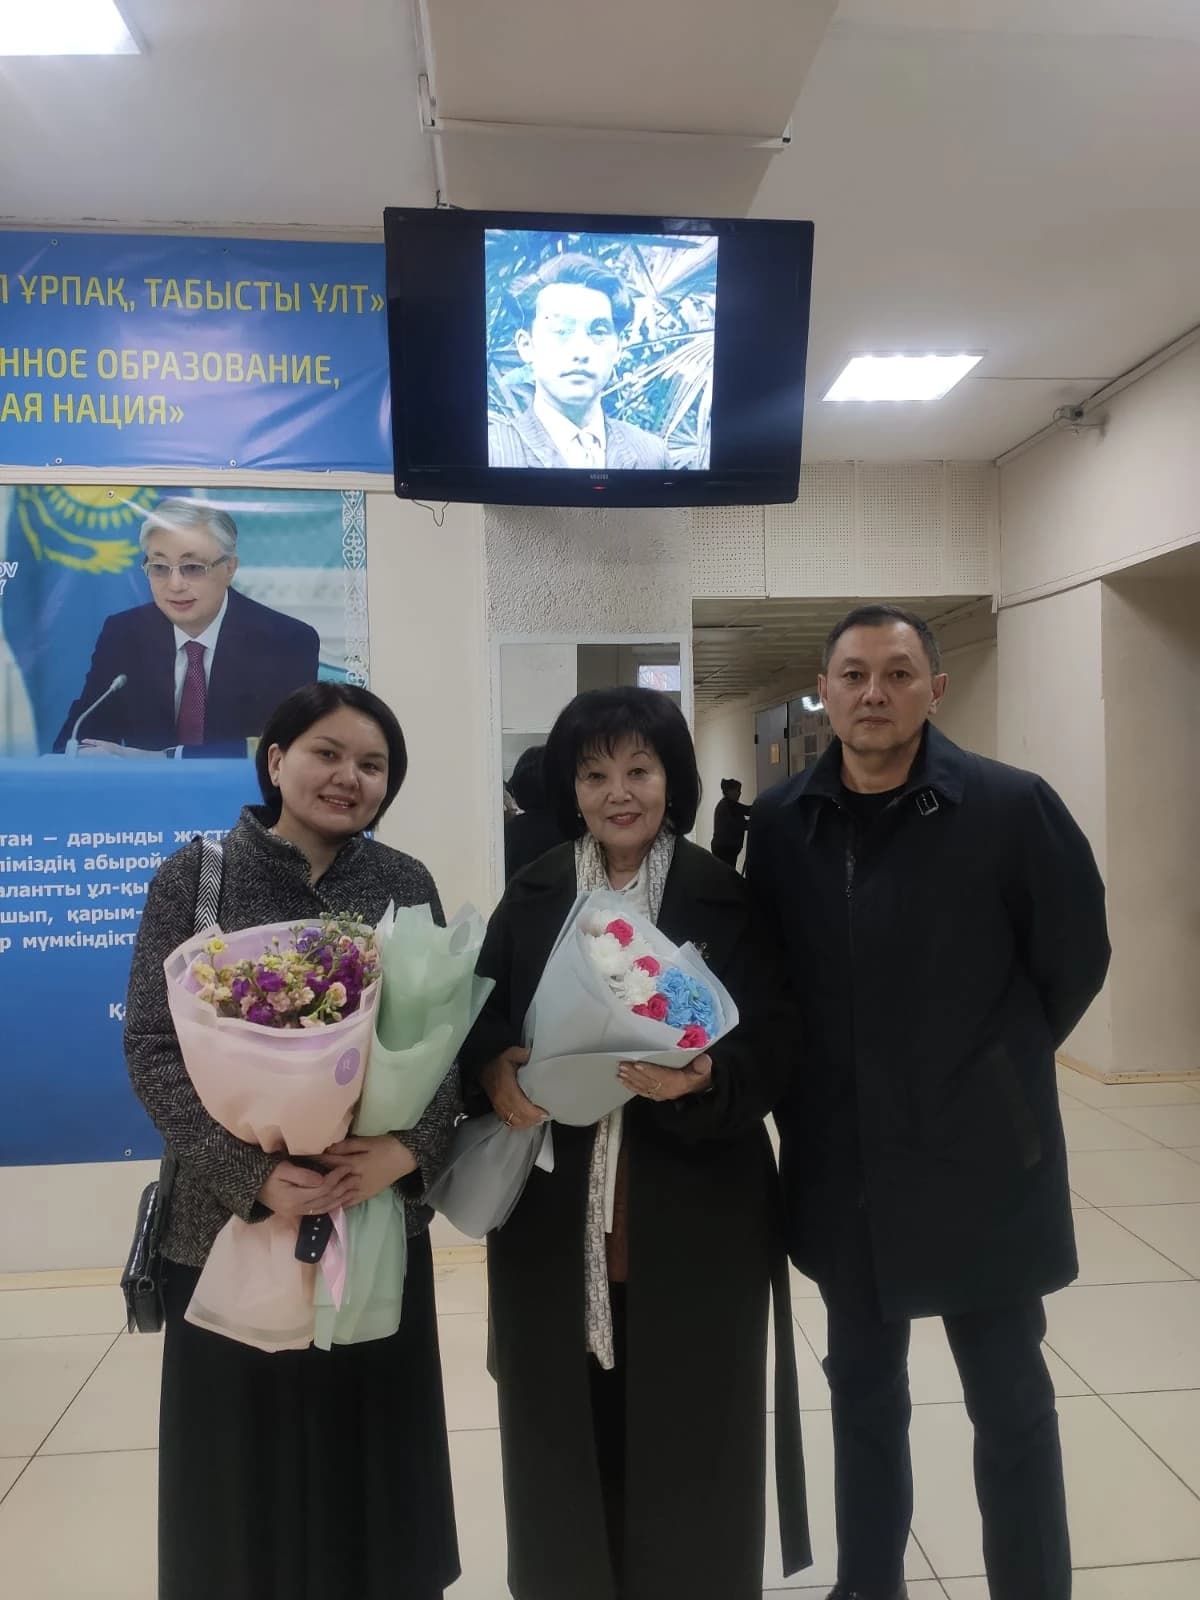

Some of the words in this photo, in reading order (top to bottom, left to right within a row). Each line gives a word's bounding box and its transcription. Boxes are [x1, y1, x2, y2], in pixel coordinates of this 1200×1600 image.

[19, 275, 135, 312] ҰРПАҚ,
[144, 278, 302, 312] ТАБЫСТЫ
[310, 282, 384, 314] ҰЛТ»
[0, 347, 88, 379] ННОЕ
[97, 348, 340, 390] ОБРАЗОВАНИЕ,
[0, 392, 42, 422] АЯ
[54, 394, 184, 430] НАЦИЯ»
[67, 831, 163, 848] дарынды
[84, 852, 167, 872] абырой
[0, 911, 54, 926] шып,
[23, 930, 139, 951] мүмкіндікт
